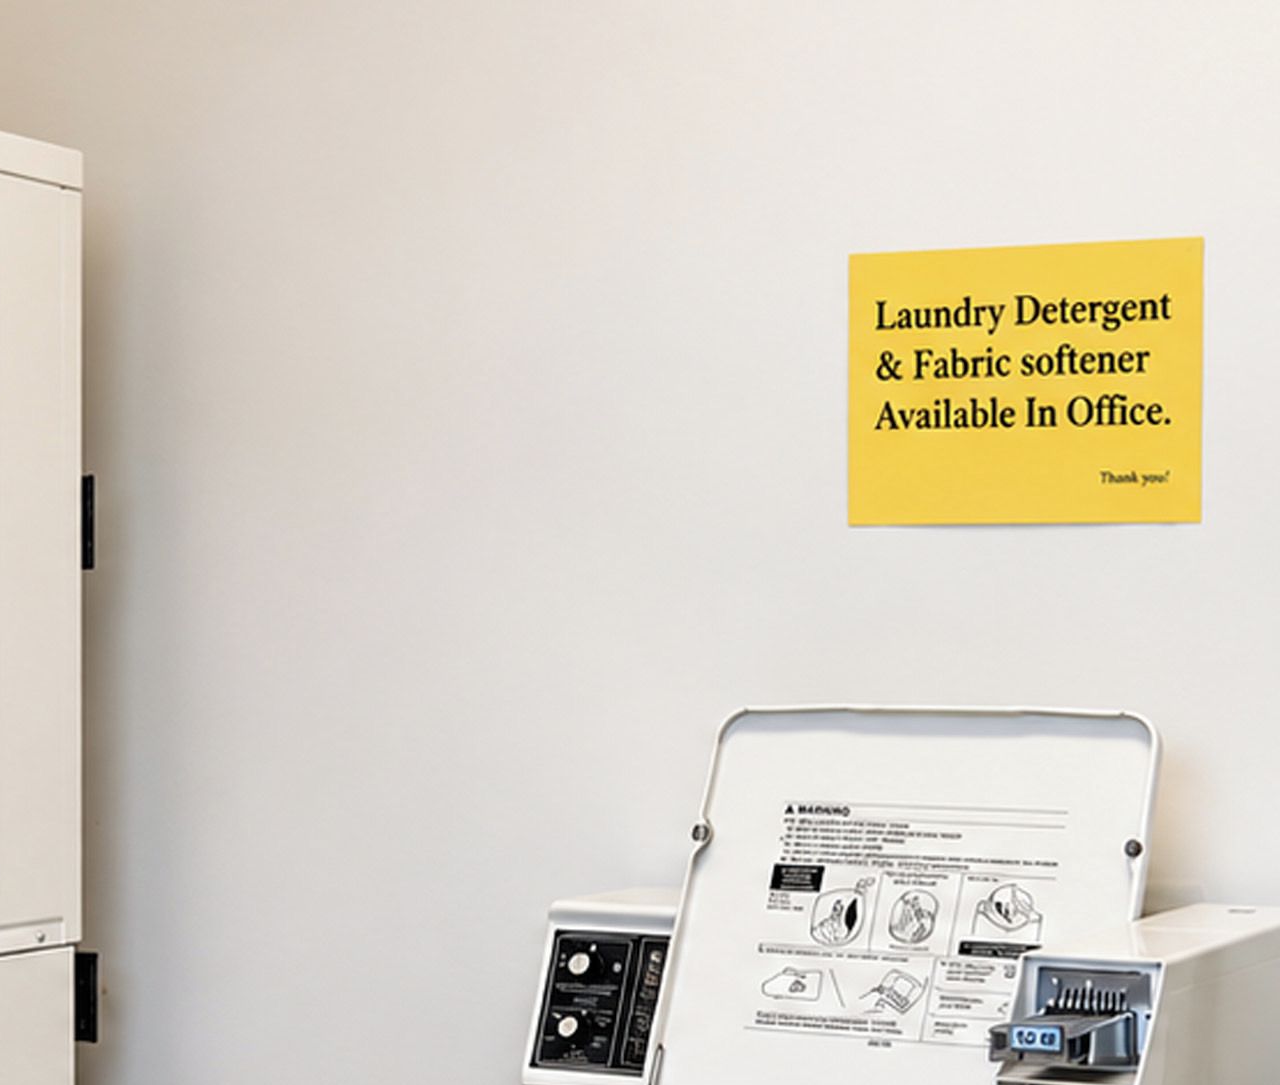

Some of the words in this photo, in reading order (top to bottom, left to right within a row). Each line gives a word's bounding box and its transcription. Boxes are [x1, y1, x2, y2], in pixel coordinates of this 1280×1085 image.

[875, 295, 1006, 336] Laundry
[1014, 293, 1172, 333] Detergent
[875, 350, 904, 382] &
[912, 346, 1012, 381] Fabric
[1020, 342, 1151, 377] softener
[874, 396, 1017, 431] Available
[1025, 396, 1058, 428] In
[1066, 393, 1172, 428] Office.
[1100, 471, 1139, 484] Thank
[1141, 470, 1170, 487] you!
